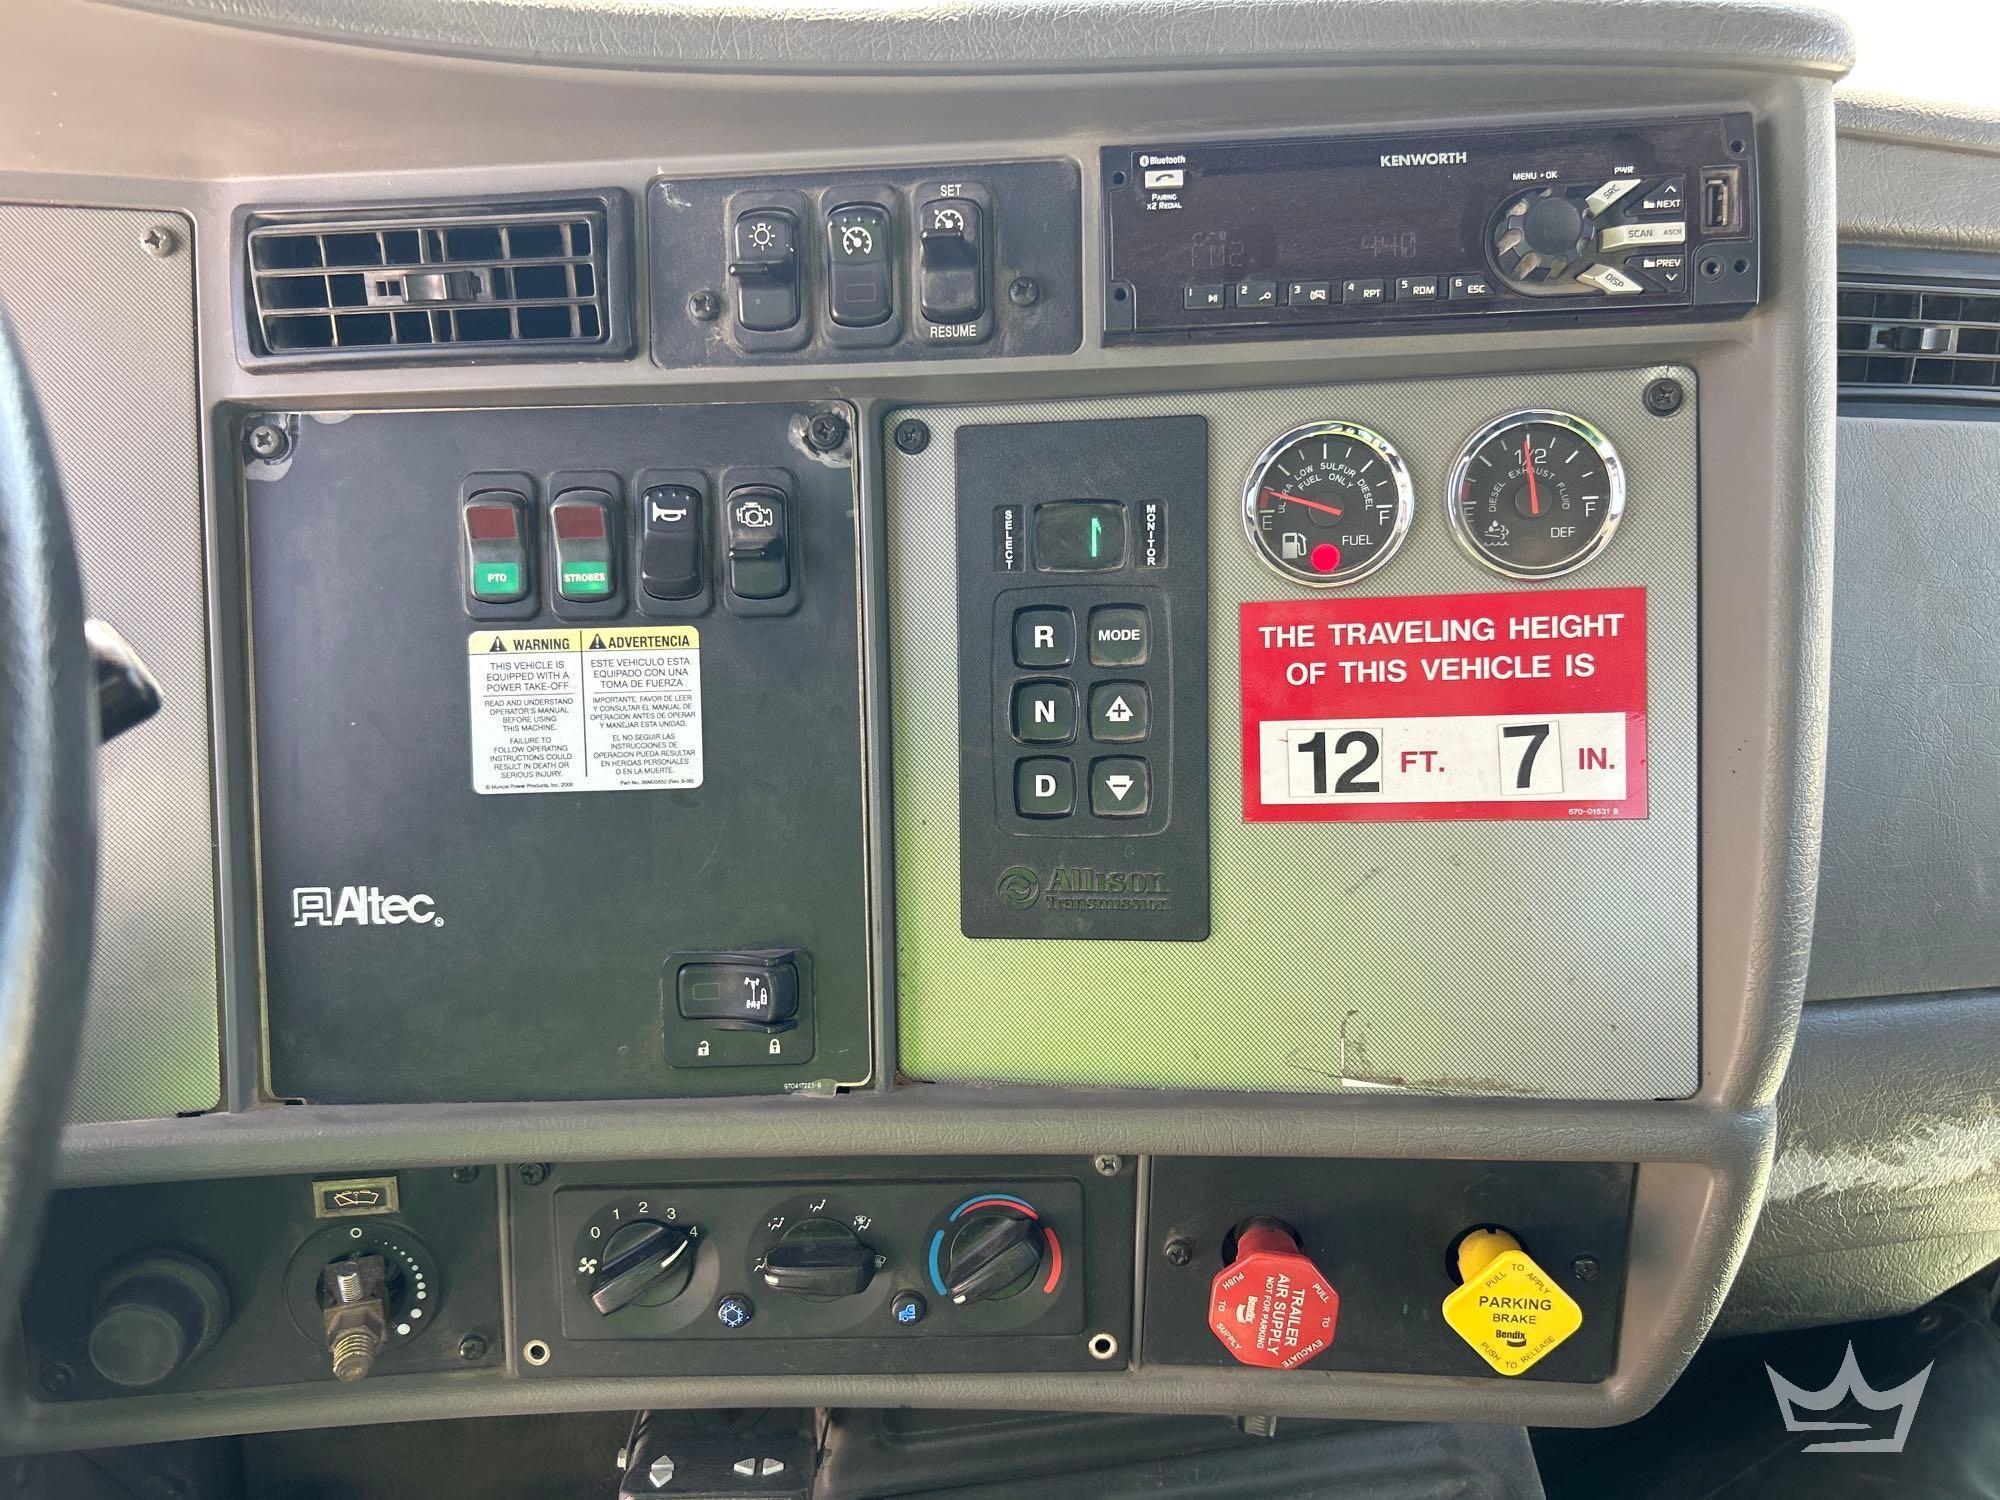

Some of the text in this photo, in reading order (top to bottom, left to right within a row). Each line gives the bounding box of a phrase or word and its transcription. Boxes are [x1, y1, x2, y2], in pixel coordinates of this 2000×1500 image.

[1150, 155, 1185, 165] Bluetooth
[1380, 151, 1467, 167] KENWORTH
[1513, 171, 1557, 180] MENU OK
[1614, 166, 1634, 174] PWR
[940, 184, 961, 197] SET
[1604, 184, 1619, 199] SRC
[1656, 199, 1680, 208] NEXT
[1656, 259, 1681, 267] PREV
[1605, 274, 1624, 287] DISP
[1242, 286, 1247, 294] 2
[1364, 289, 1381, 298] RPT
[1413, 286, 1434, 295] RDM
[1468, 285, 1485, 294] ESC
[930, 325, 976, 338] RESUME
[1294, 465, 1313, 480] LOW
[1320, 463, 1356, 478] SULFUR
[1357, 479, 1373, 510] DIESEL
[1298, 474, 1353, 490] FUEL ONLY
[1488, 482, 1505, 512] DIESEL
[1556, 483, 1569, 509] FLUID
[1585, 502, 1595, 517] F
[1262, 515, 1272, 530] E
[1379, 510, 1390, 525] F
[1146, 505, 1156, 566] MONITOR
[1551, 527, 1575, 537] DEF
[1005, 510, 1013, 570] SELECT
[1342, 535, 1373, 545] FUEL
[488, 574, 507, 583] PTO
[564, 573, 606, 583] STROBES
[1034, 626, 1054, 648] R
[1098, 630, 1140, 641] MODE
[1259, 613, 1624, 648] THE TRAVELING HEIGHT
[513, 638, 569, 650] WARNING
[608, 635, 690, 648] ADVERTENCIA
[490, 662, 511, 670] THIS
[514, 661, 553, 669] VEHICLE
[591, 657, 690, 667] ESTE VEHICULO ESTA
[594, 668, 688, 678] EQUIPADO CON UNA
[1286, 653, 1594, 685] OF THIS VEHICLE IS
[487, 672, 534, 681] EQUIPPED
[487, 682, 568, 692] POWER TAKE-OFF
[601, 680, 628, 688] TOMA
[646, 679, 683, 687] FUERZA
[524, 698, 573, 706] UNDERSTAND
[590, 713, 630, 721] OPERACION
[1034, 700, 1055, 723] N
[1298, 724, 1615, 794] 12 FT. 7 IN.
[501, 771, 533, 779] SERIOUS
[1035, 775, 1056, 797] D
[1048, 868, 1168, 894] Allison
[334, 886, 435, 925] Altec
[1046, 895, 1170, 910] Transmission
[590, 1201, 698, 1239] 0 1 2 3 4
[1486, 1272, 1507, 1287] PULL
[1526, 1273, 1550, 1294] APPLY
[1245, 1296, 1258, 1324] Bendix
[1479, 1296, 1551, 1311] PARKING
[1216, 1272, 1244, 1349] PUSH TO SUPPLY
[1257, 1276, 1274, 1348] NOT FOR PARKING
[1267, 1273, 1290, 1356] AIR SUPPLY
[1284, 1289, 1305, 1347] TRAILER
[1493, 1314, 1537, 1324] BRAKE
[1282, 1283, 1330, 1368] PULL TO EVACUATE
[1496, 1330, 1526, 1339] Bendix
[1481, 1342, 1500, 1361] PUSH
[1521, 1336, 1555, 1363] RELEASE
